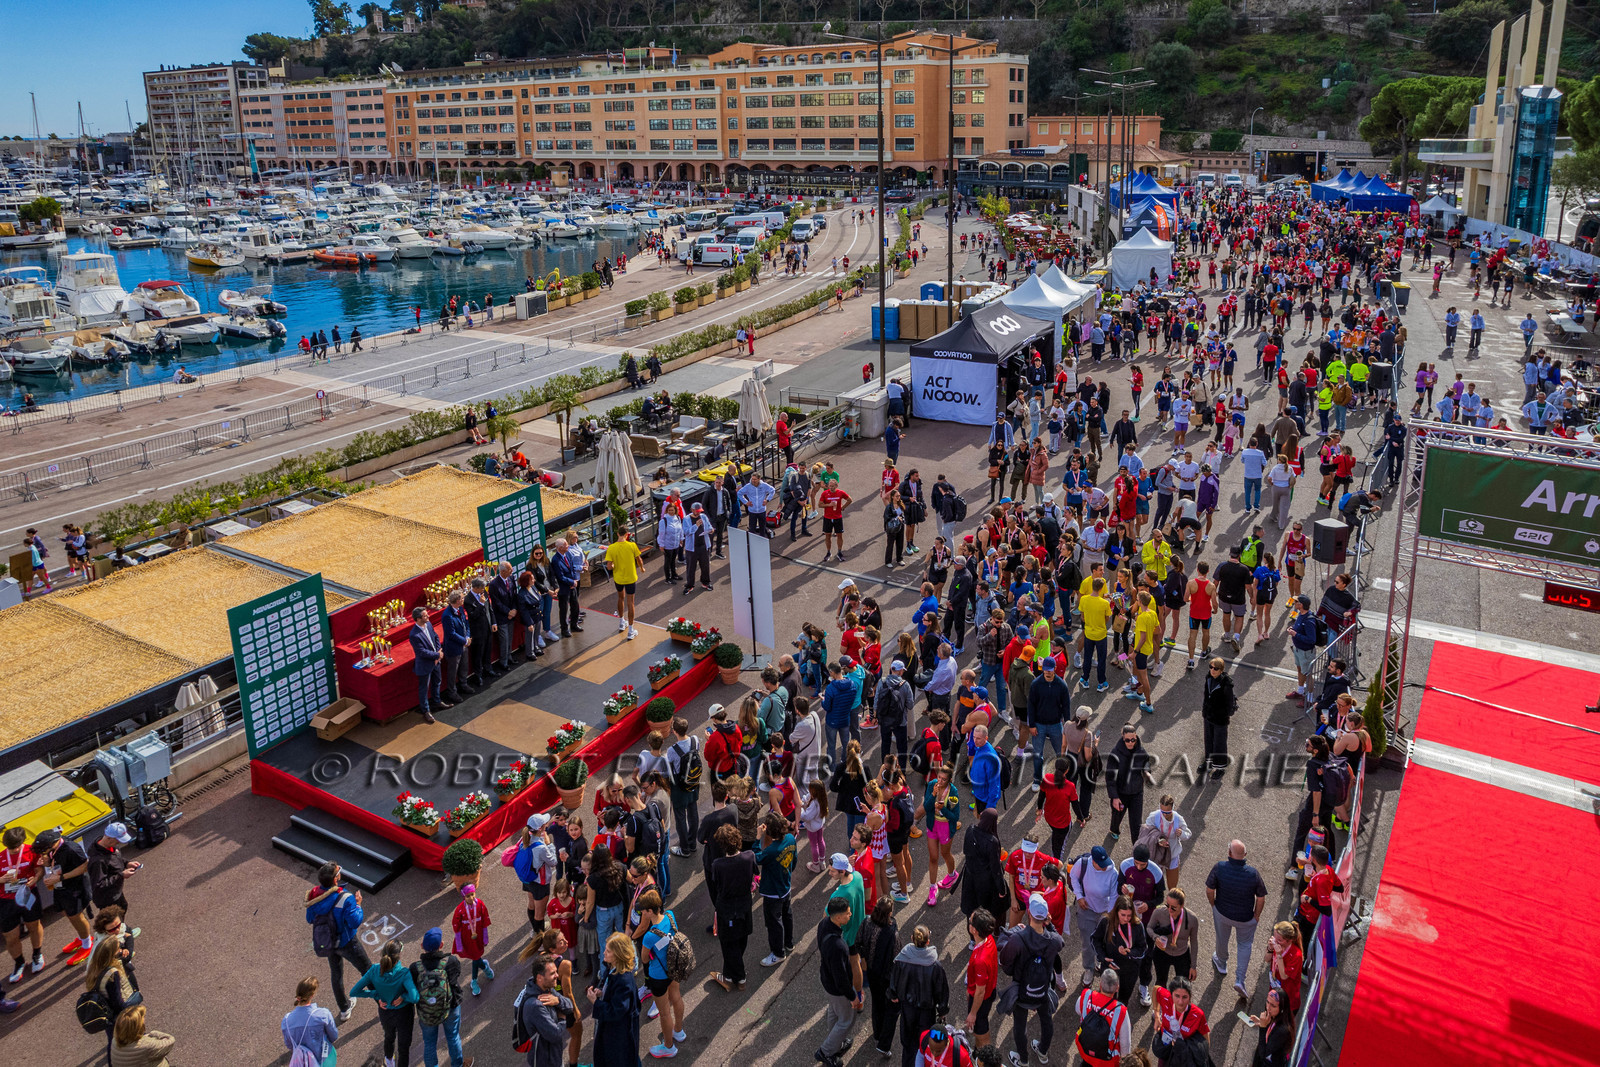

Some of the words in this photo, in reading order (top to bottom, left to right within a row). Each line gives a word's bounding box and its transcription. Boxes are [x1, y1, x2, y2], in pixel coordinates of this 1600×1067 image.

[924, 376, 953, 389] ACT
[922, 389, 982, 406] NOOOW.
[1518, 531, 1549, 543] 42K
